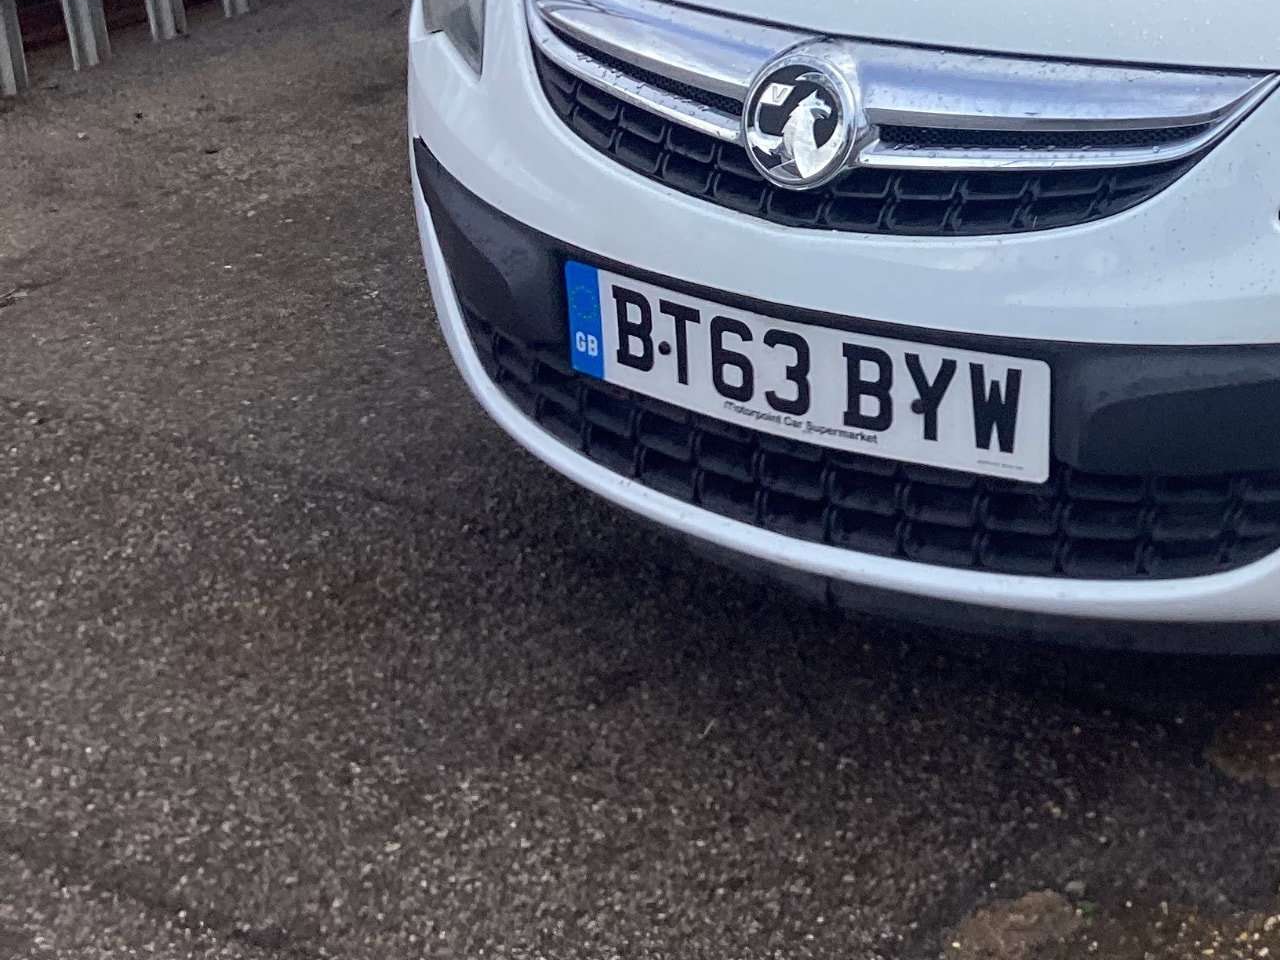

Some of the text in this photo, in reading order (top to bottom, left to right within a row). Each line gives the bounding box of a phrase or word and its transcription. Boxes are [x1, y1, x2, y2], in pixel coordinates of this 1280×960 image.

[575, 331, 598, 357] GB
[611, 284, 1023, 454] BT63 BYW
[805, 420, 879, 444] Supermarket
